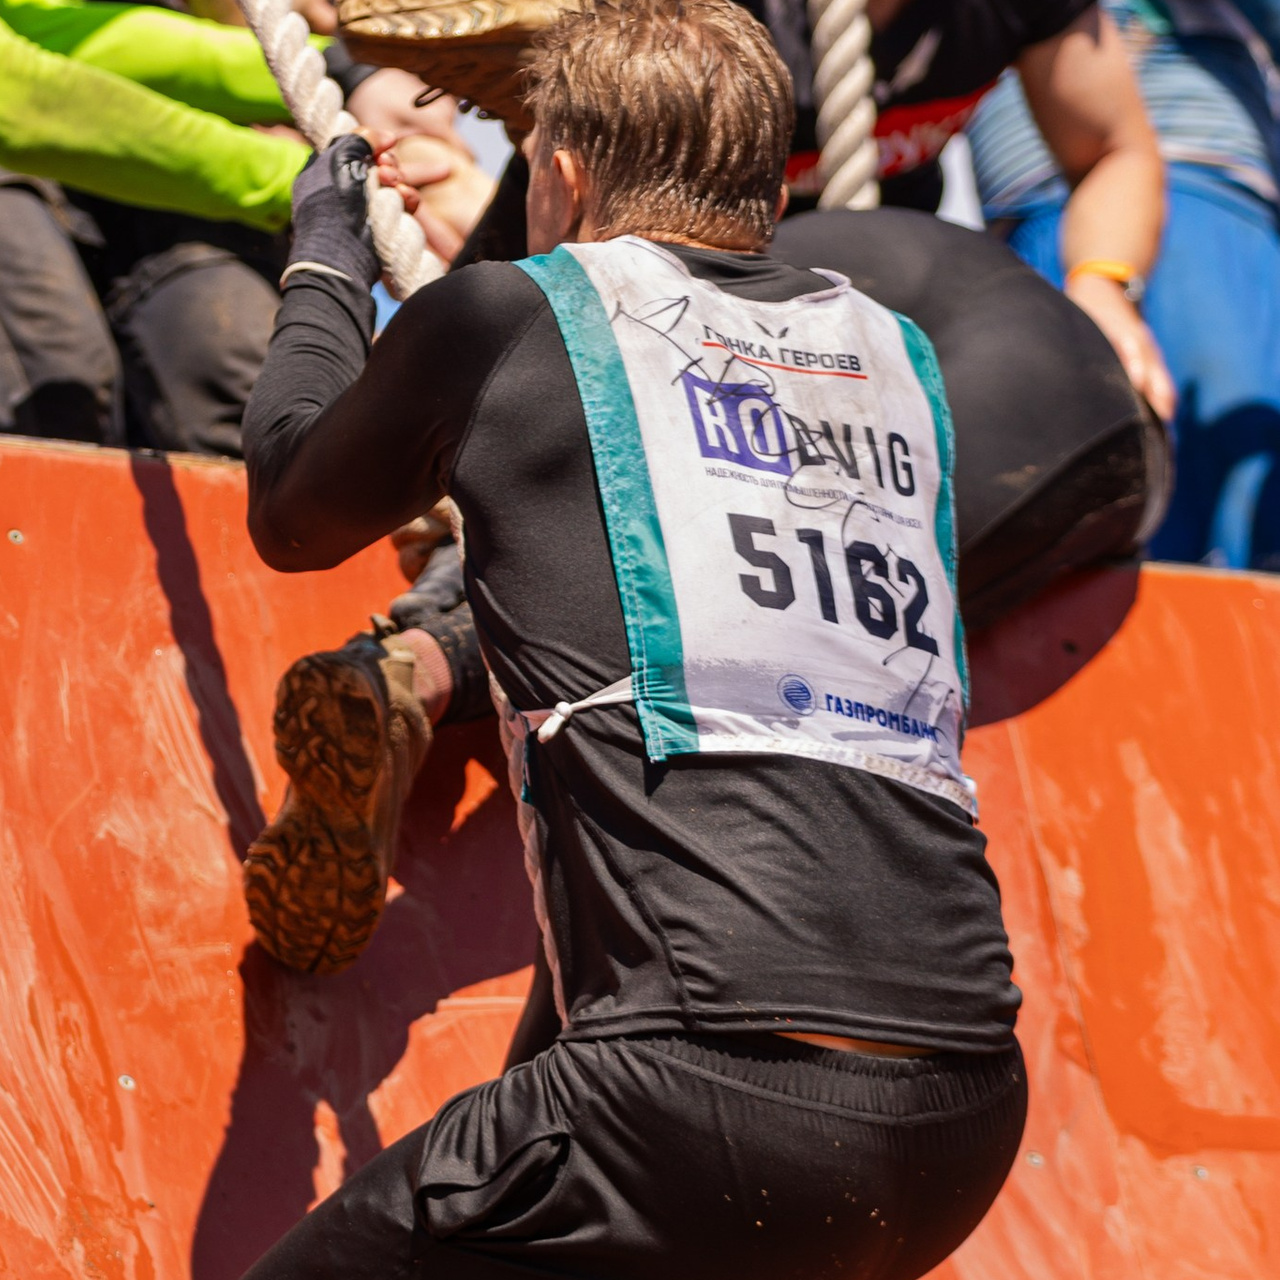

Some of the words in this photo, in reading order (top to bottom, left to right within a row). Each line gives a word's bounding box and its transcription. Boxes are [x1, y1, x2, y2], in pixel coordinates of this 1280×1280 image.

[778, 347, 862, 372] ГЕРОЕВ
[727, 512, 940, 658] 5162
[824, 693, 938, 744] ГАЗПРОМБАНК
